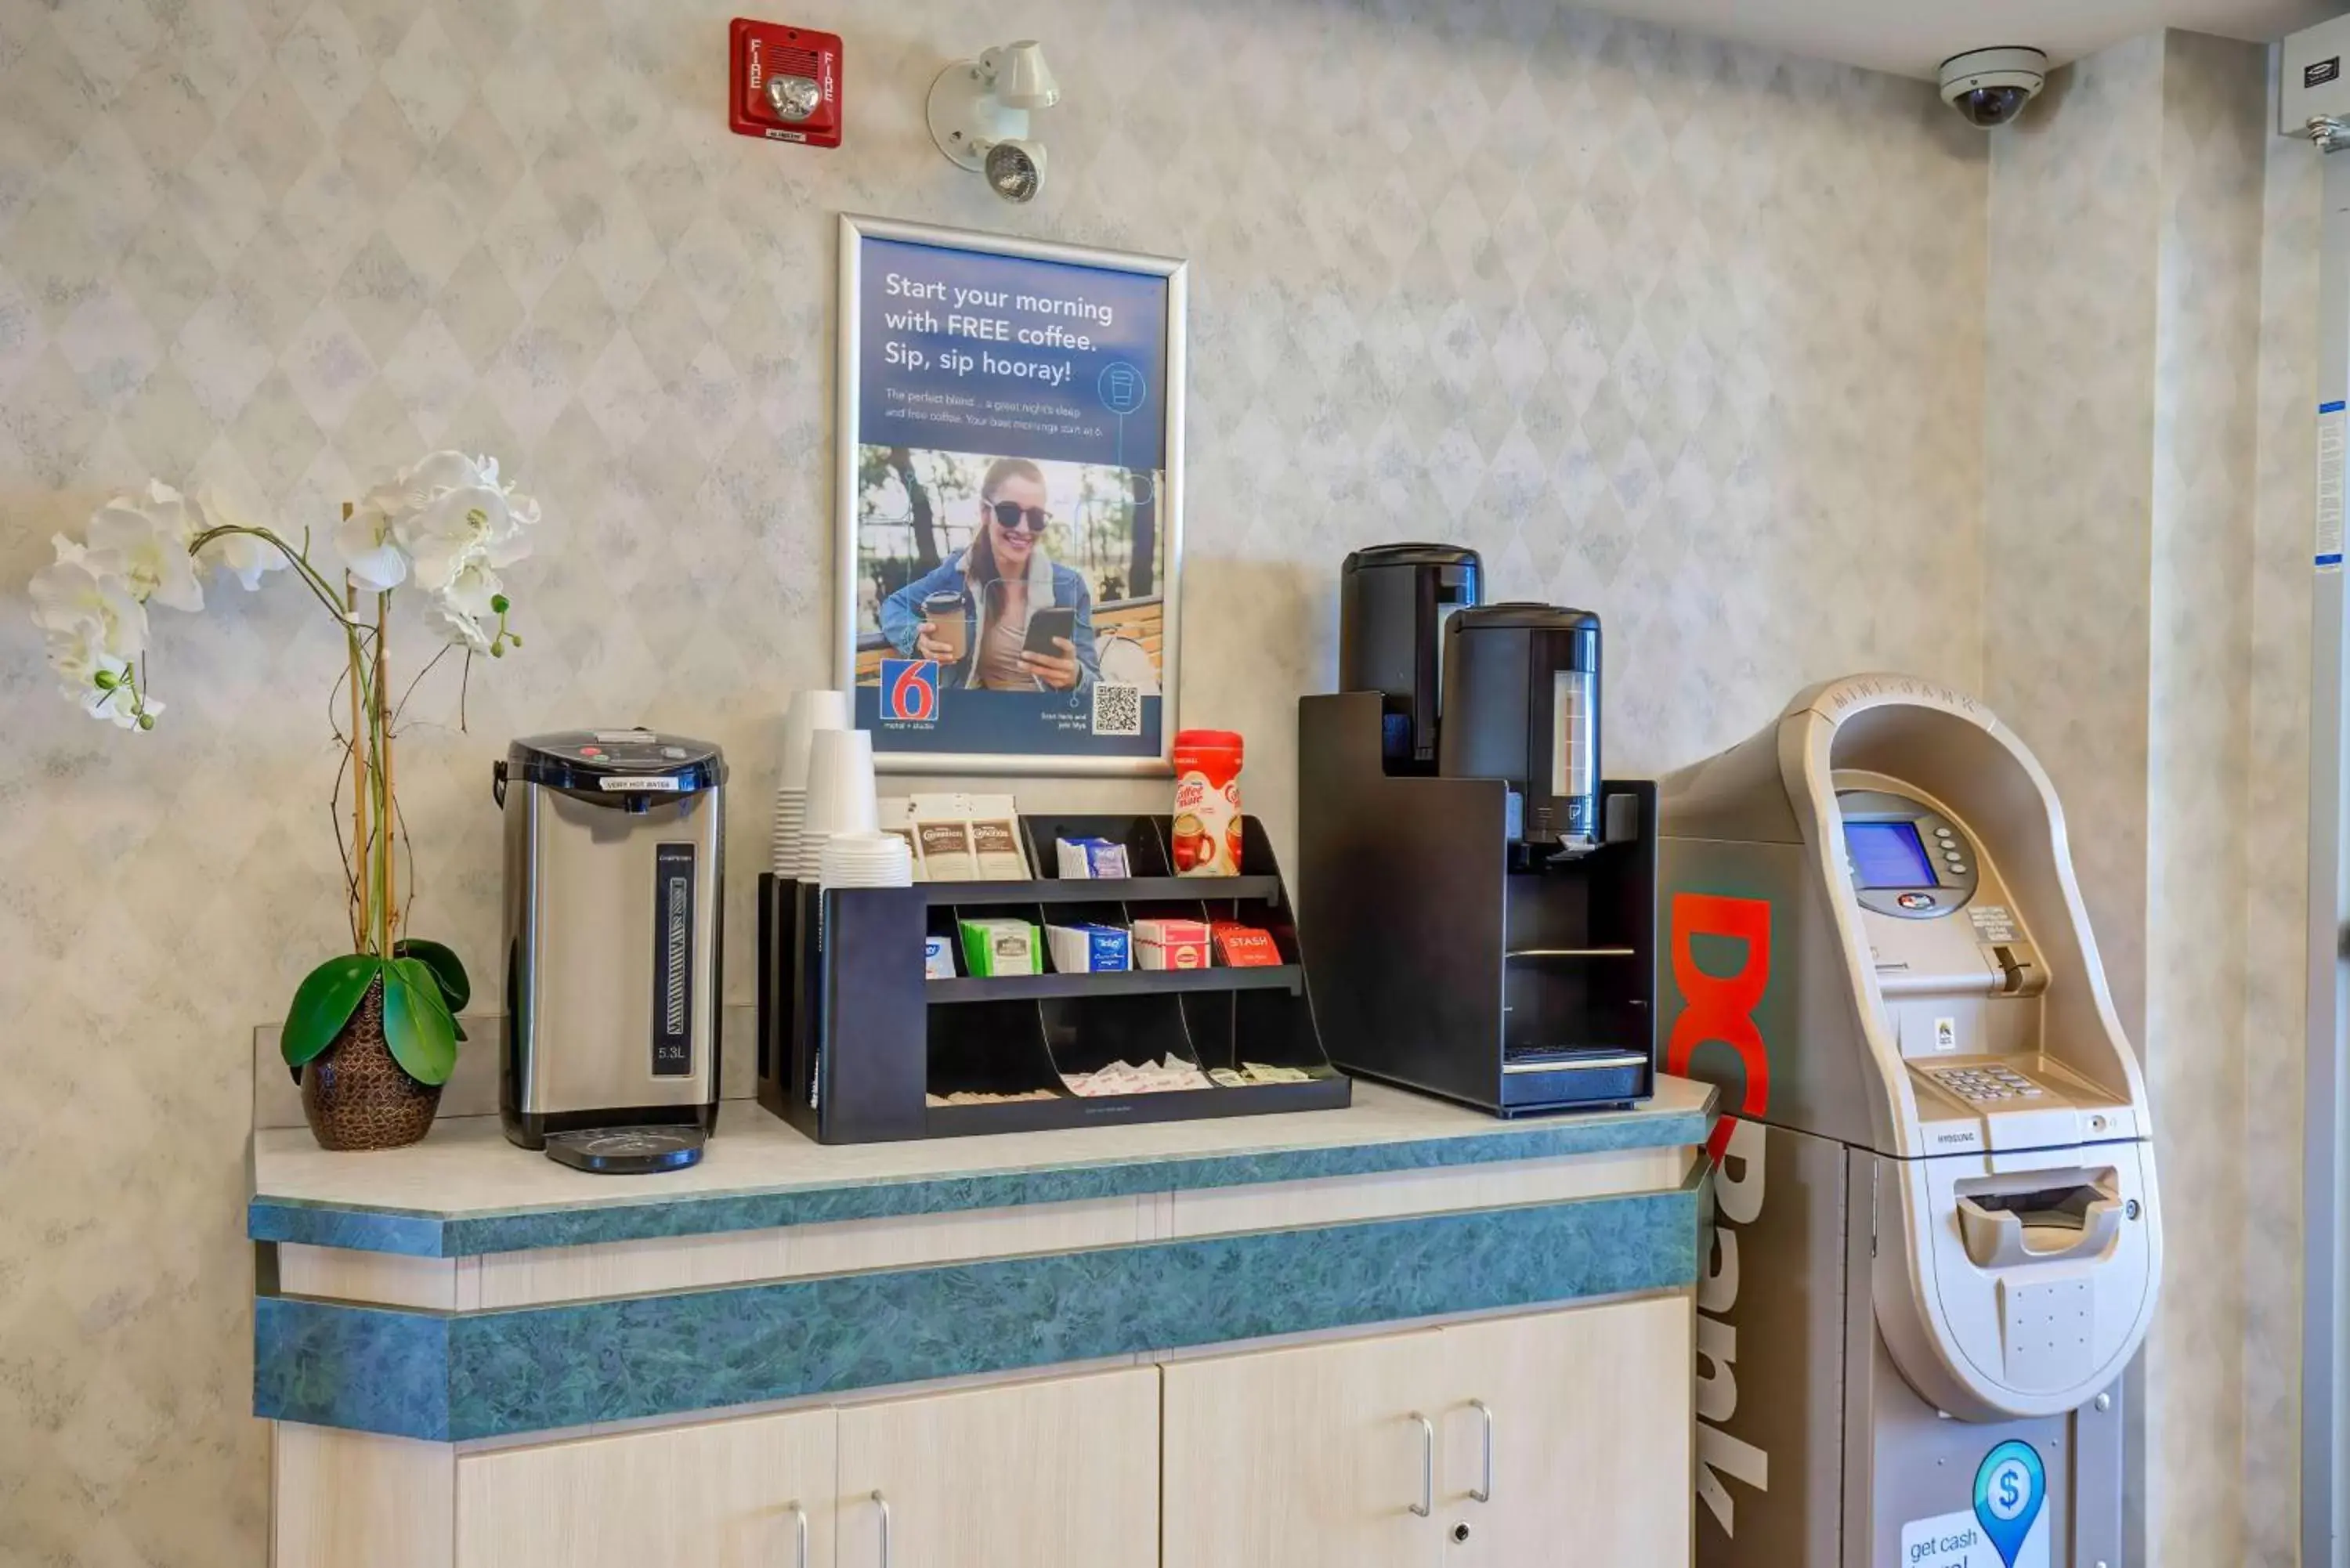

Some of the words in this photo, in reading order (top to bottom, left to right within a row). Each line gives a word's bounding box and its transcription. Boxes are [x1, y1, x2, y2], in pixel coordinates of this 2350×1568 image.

[750, 39, 761, 89] FIRE
[825, 52, 833, 102] FIRE
[886, 273, 946, 301] Start
[953, 287, 1009, 309] your
[1016, 295, 1112, 327] morning
[885, 309, 938, 333] with
[948, 314, 1010, 341] FREE
[1018, 325, 1097, 352] coffee.
[884, 341, 930, 372] Sip,
[939, 349, 974, 377] sip
[983, 351, 1071, 386] hooray!
[886, 388, 905, 399] The
[892, 659, 934, 720] 6
[1229, 936, 1267, 948] STASH
[1911, 1537, 1936, 1563] get
[1940, 1528, 1978, 1552] cash
